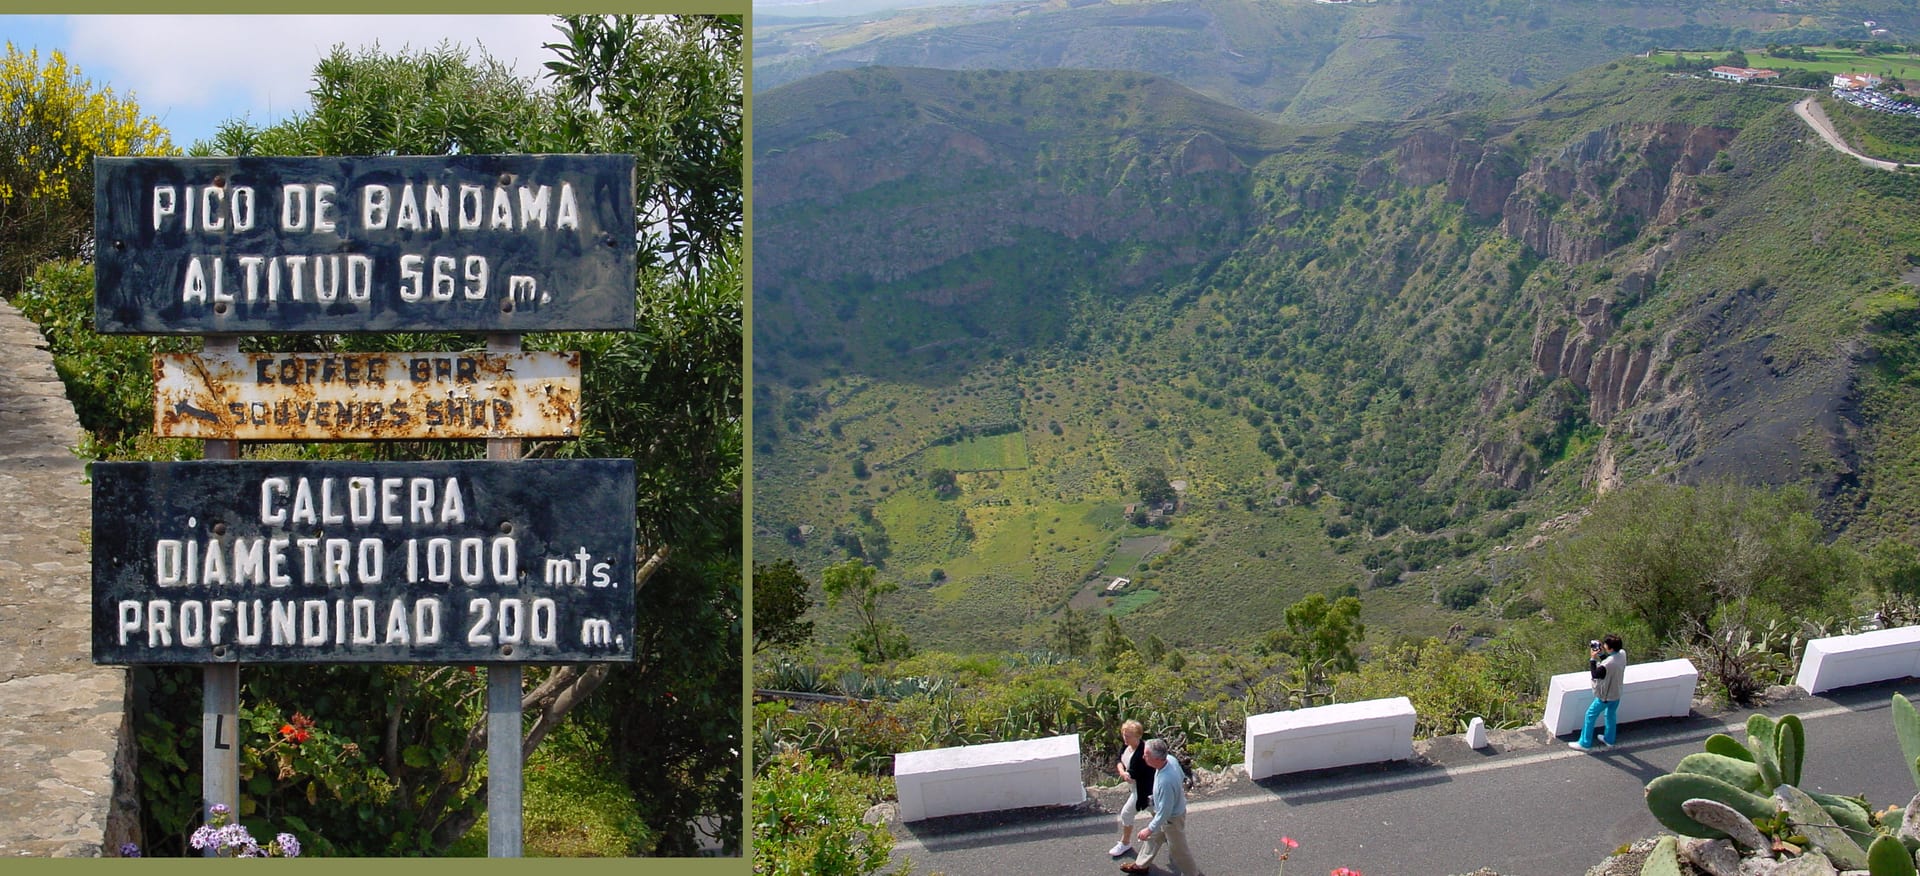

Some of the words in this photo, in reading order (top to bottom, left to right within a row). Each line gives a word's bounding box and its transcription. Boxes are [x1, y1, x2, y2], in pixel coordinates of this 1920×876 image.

[152, 184, 255, 232] PICO
[282, 184, 337, 232] DE
[363, 183, 579, 232] BANDAMA
[182, 254, 373, 303] ALTITUD
[399, 254, 490, 302] 569
[509, 273, 552, 304] m.
[256, 358, 385, 386] COFFEE
[409, 357, 477, 385] BAR
[426, 398, 514, 430] SHOP
[261, 477, 466, 525] CALDERA
[544, 546, 618, 588] mts.
[118, 599, 442, 647] PROFUNDIDAD
[467, 598, 558, 646] 200
[581, 617, 625, 648] m.
[214, 713, 231, 750] L
